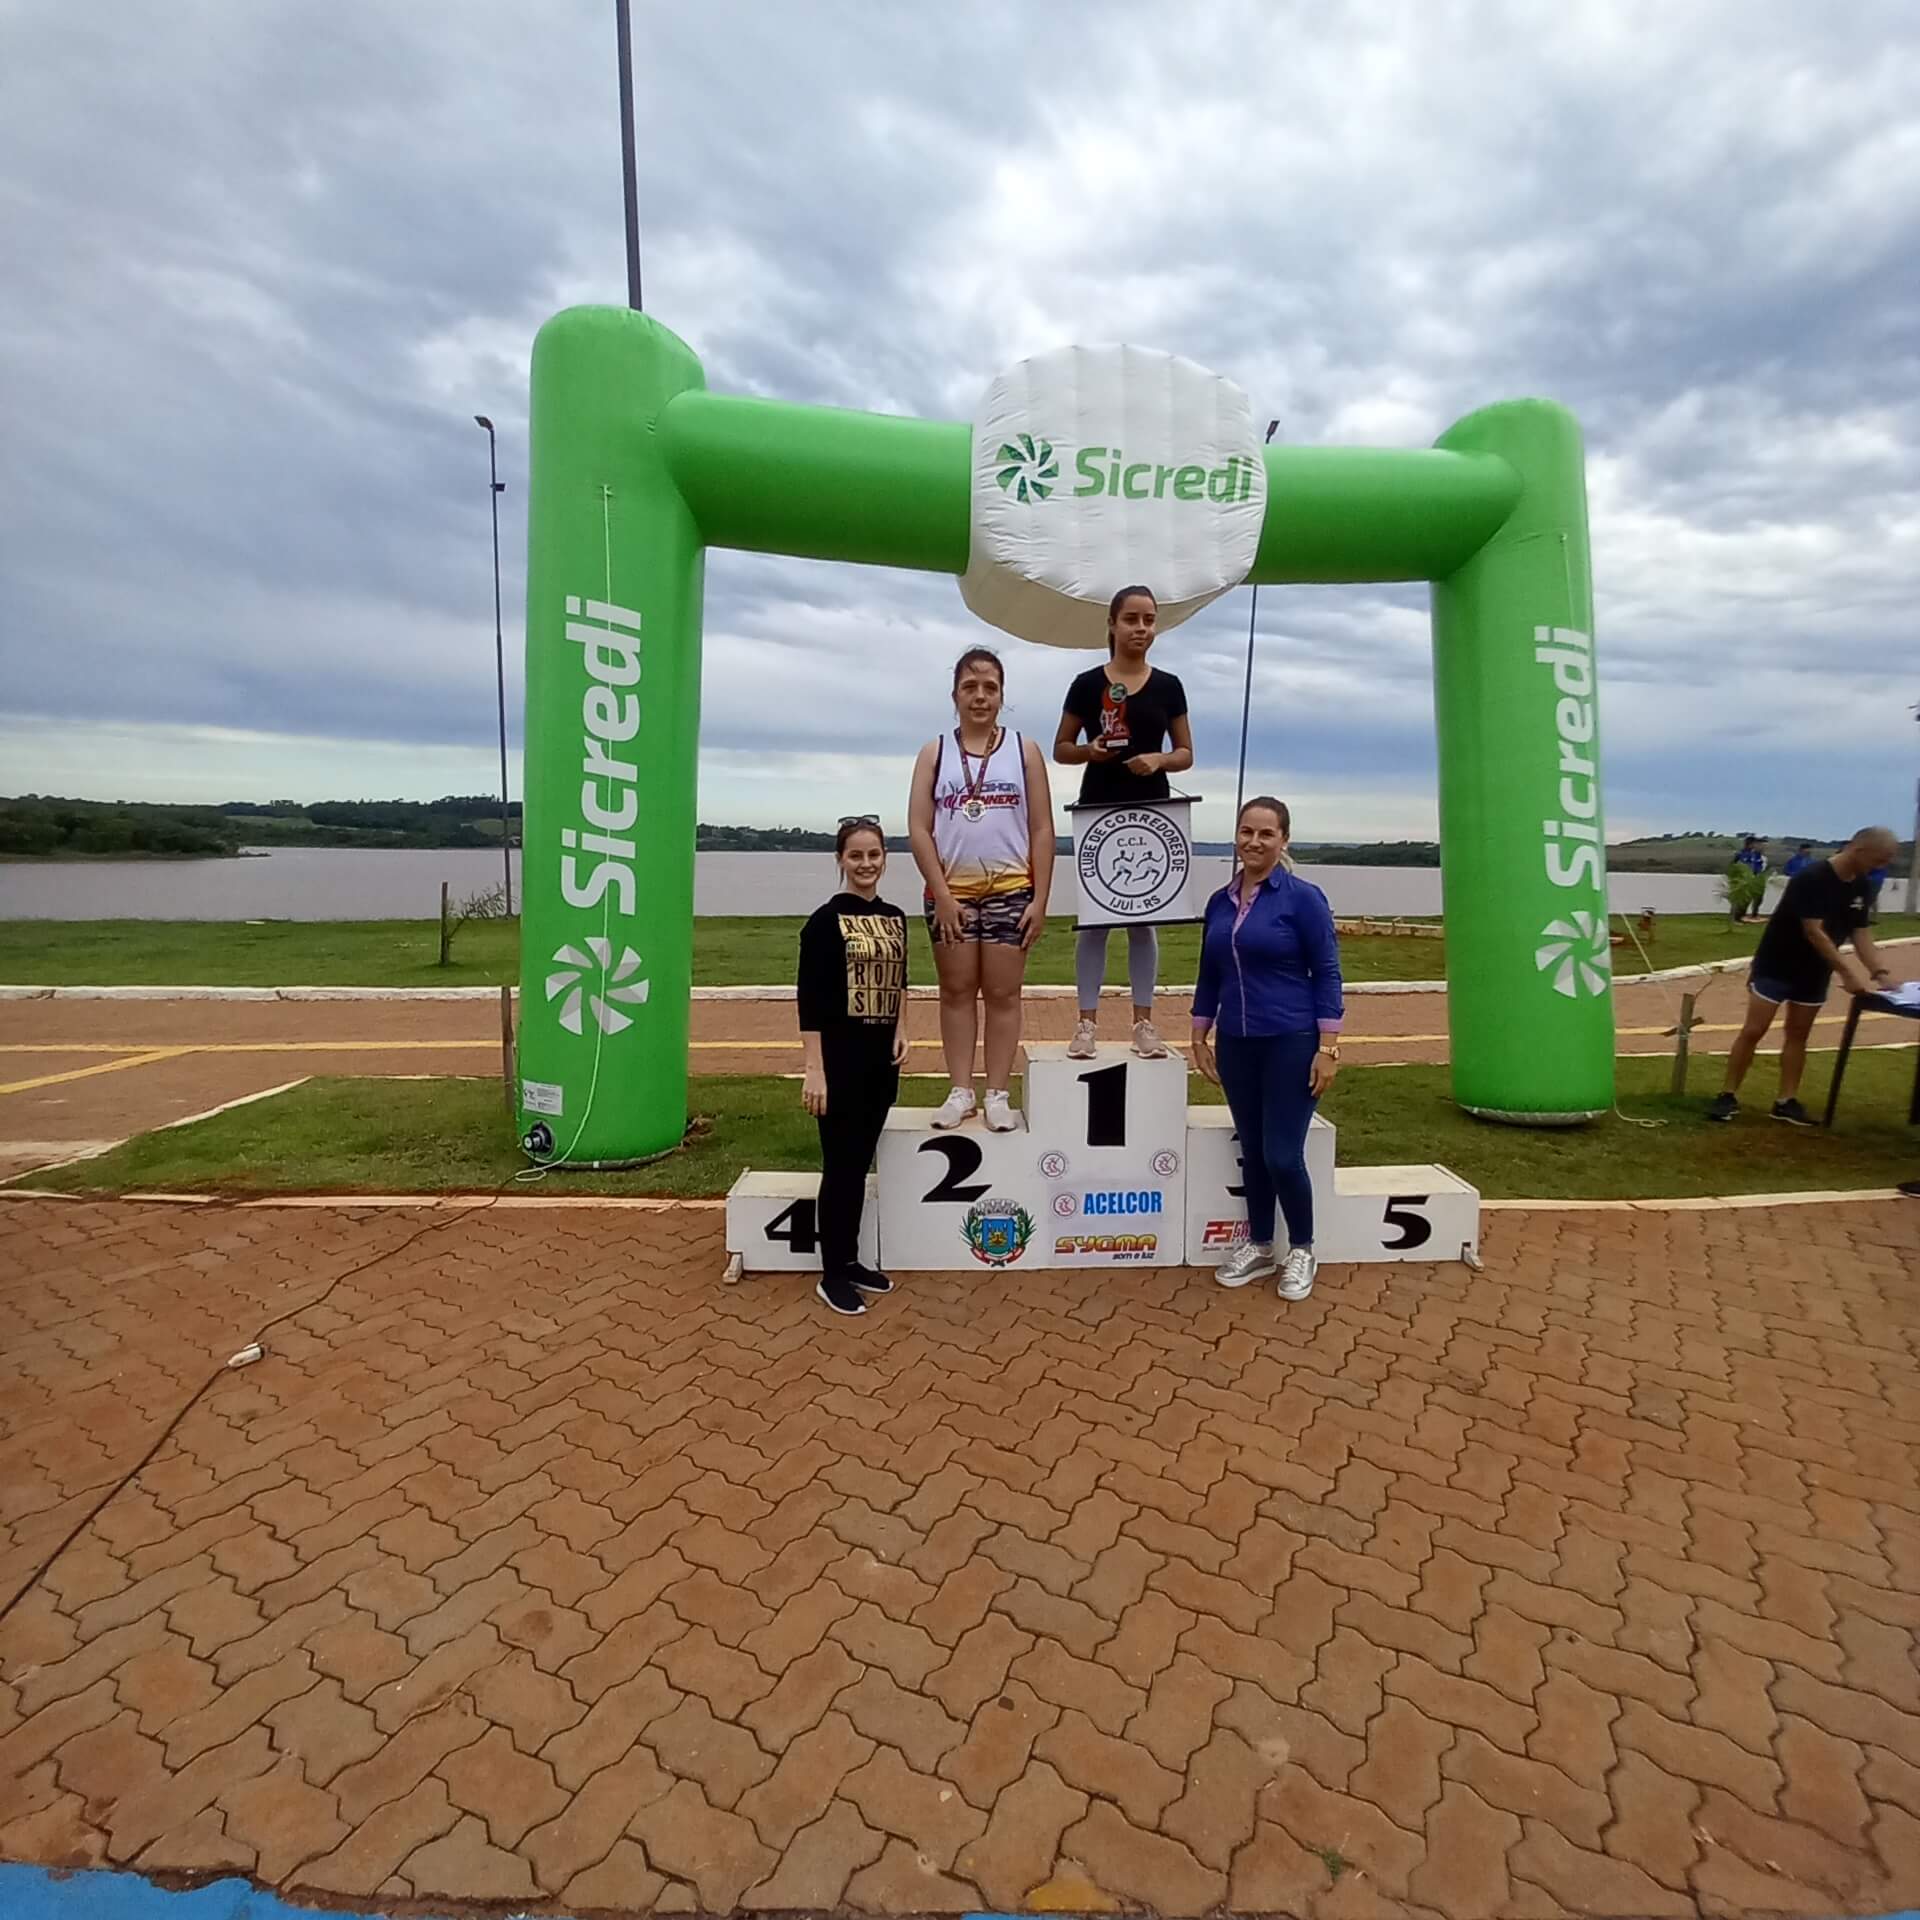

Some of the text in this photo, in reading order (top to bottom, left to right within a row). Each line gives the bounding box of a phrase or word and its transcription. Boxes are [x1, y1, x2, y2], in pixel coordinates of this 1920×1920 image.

[1073, 446, 1253, 503] Sicredi
[561, 595, 642, 916] Sicredi
[1534, 625, 1601, 891] Sicredi
[1083, 812, 1185, 878] CLUBE DE CORREDORES DE
[1143, 895, 1161, 909] RS
[1077, 1062, 1128, 1147] 1
[917, 1135, 992, 1203] 2
[764, 1199, 821, 1254] 4
[1083, 1191, 1162, 1215] ACELCOR
[1381, 1195, 1432, 1250] 5
[1055, 1234, 1158, 1254] SYGMA
